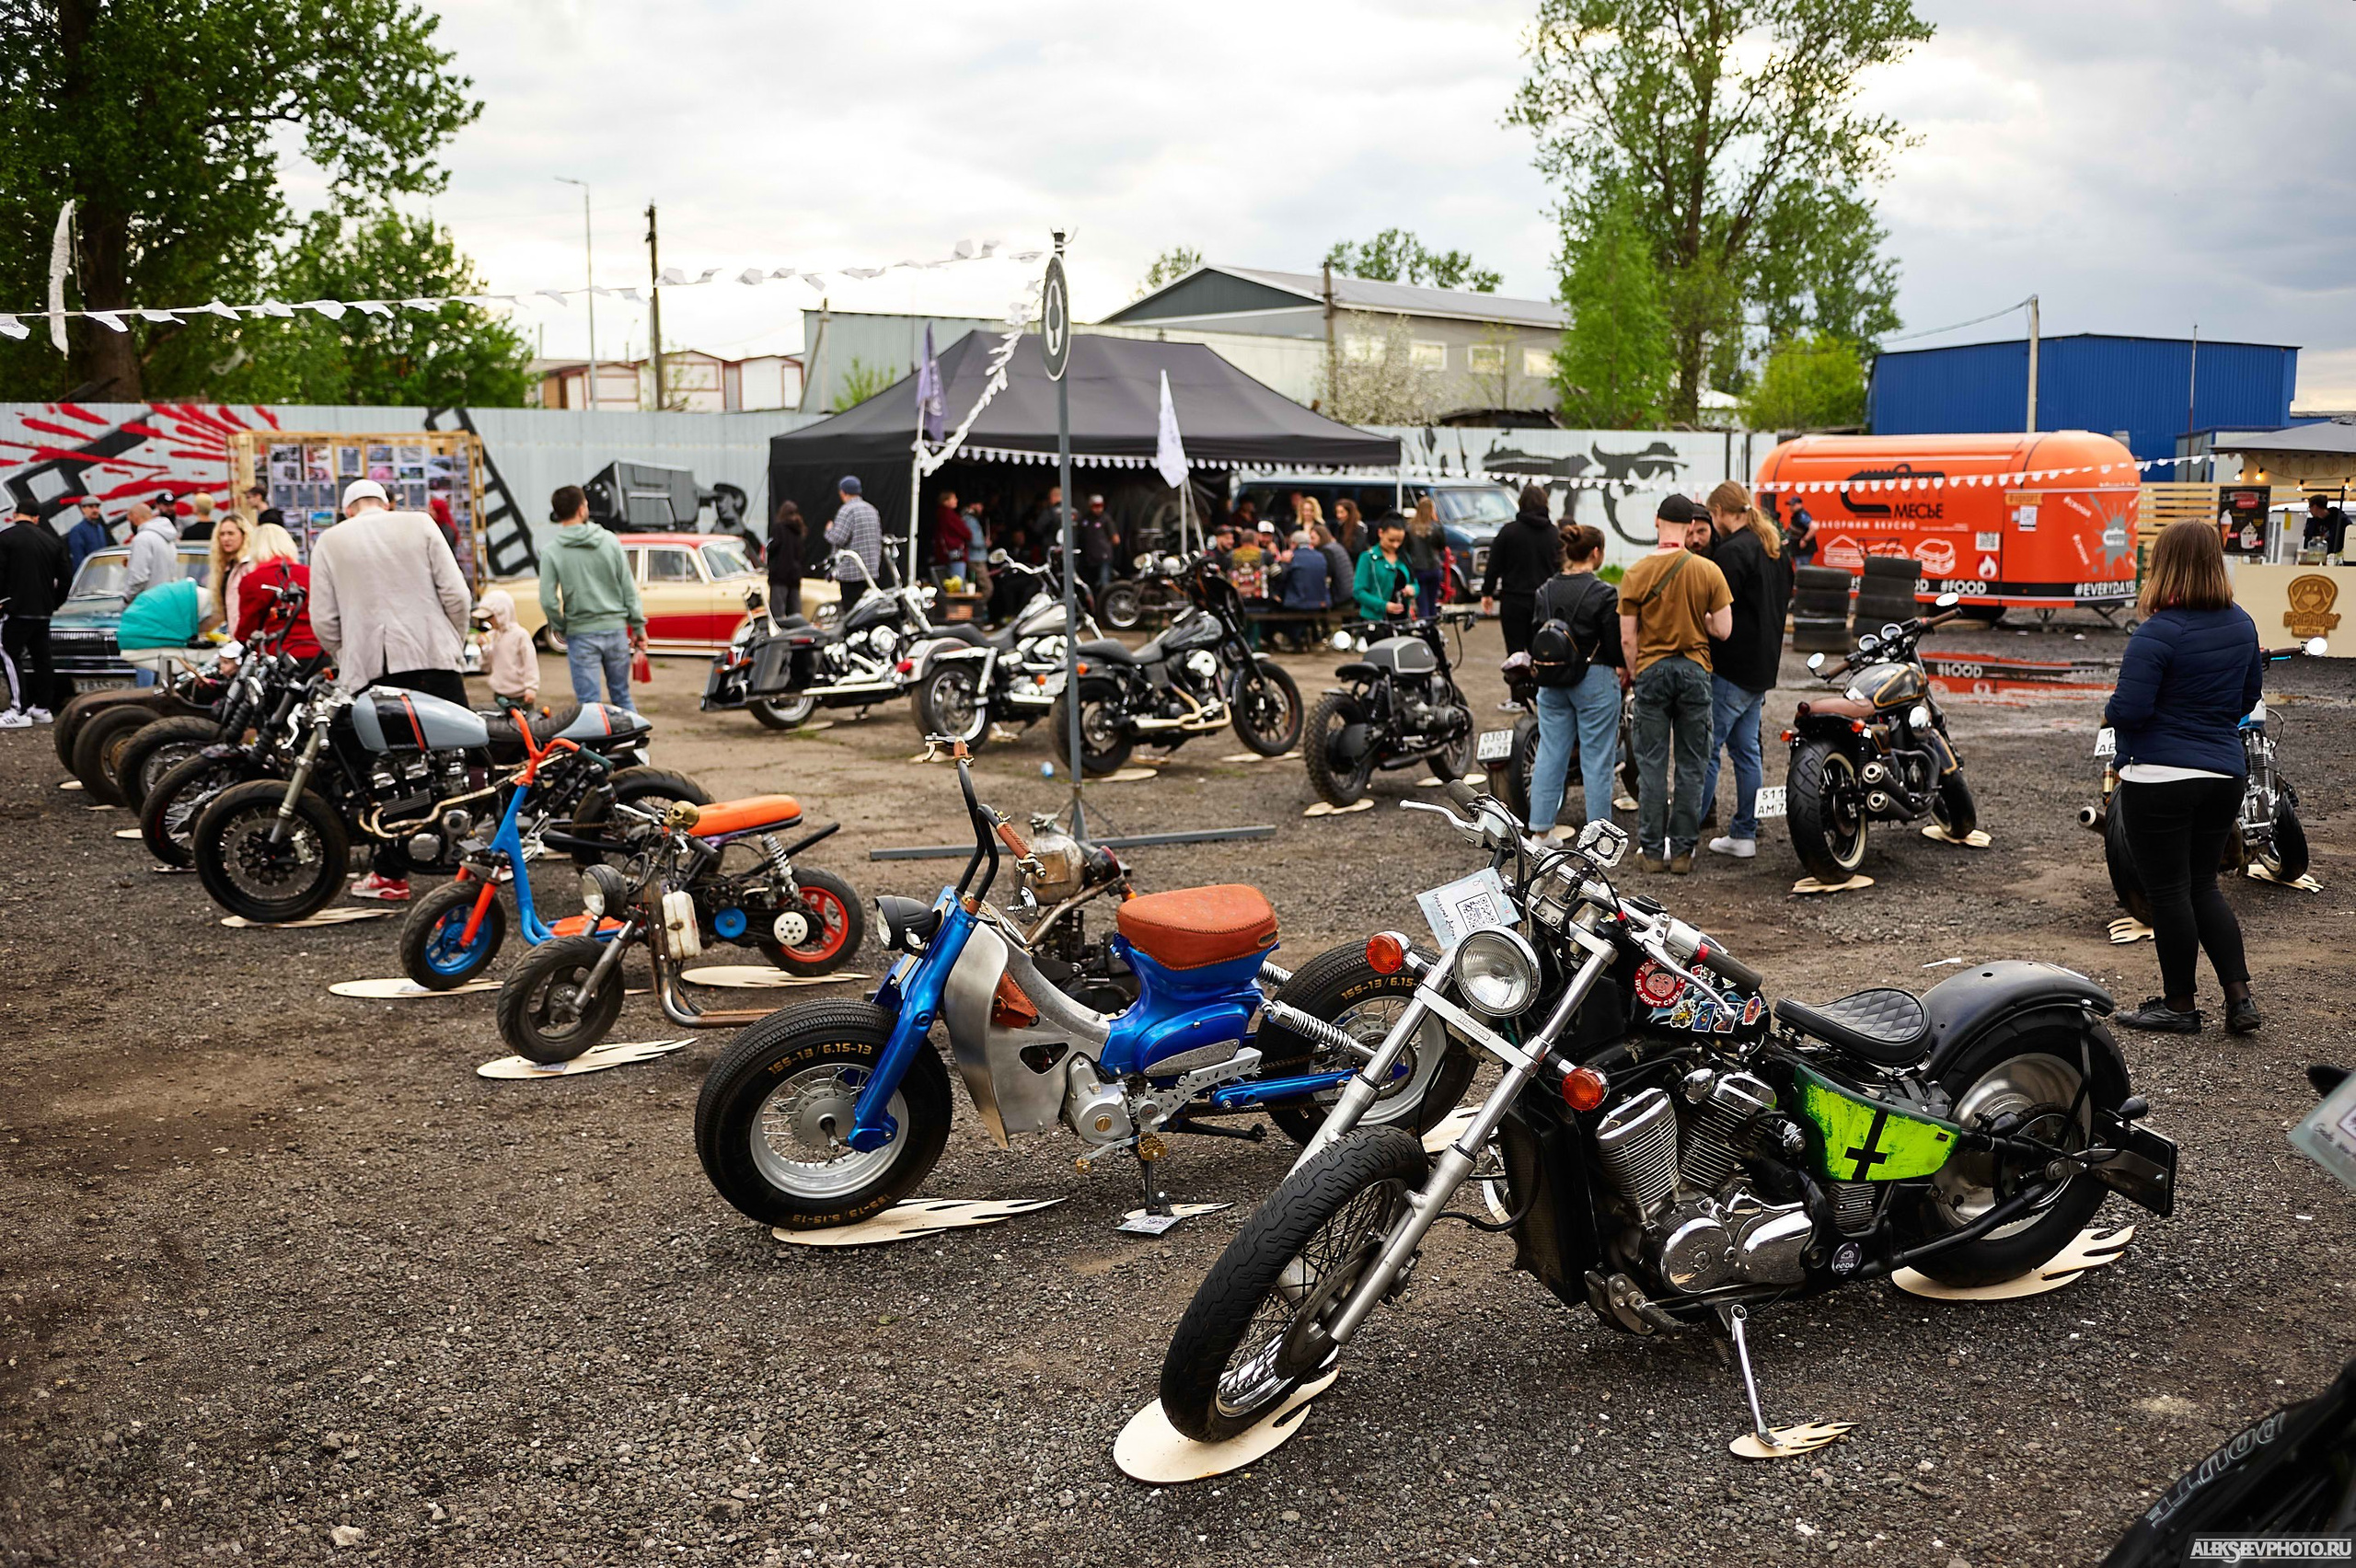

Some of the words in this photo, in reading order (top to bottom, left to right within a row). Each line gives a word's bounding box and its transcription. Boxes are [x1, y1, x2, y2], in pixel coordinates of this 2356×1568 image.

[1894, 503, 1944, 519] МЕСЬЕ
[1816, 520, 1870, 530] АКОРМИМ
[1940, 580, 1987, 595] #FOOD
[2285, 614, 2339, 627] FRIENDLY
[1761, 789, 1784, 801] 511
[1341, 976, 1418, 1000] 155-13/6.15-
[1634, 979, 1644, 992] WE
[1663, 990, 1681, 1006] CARE
[1457, 1015, 1490, 1040] HONDA
